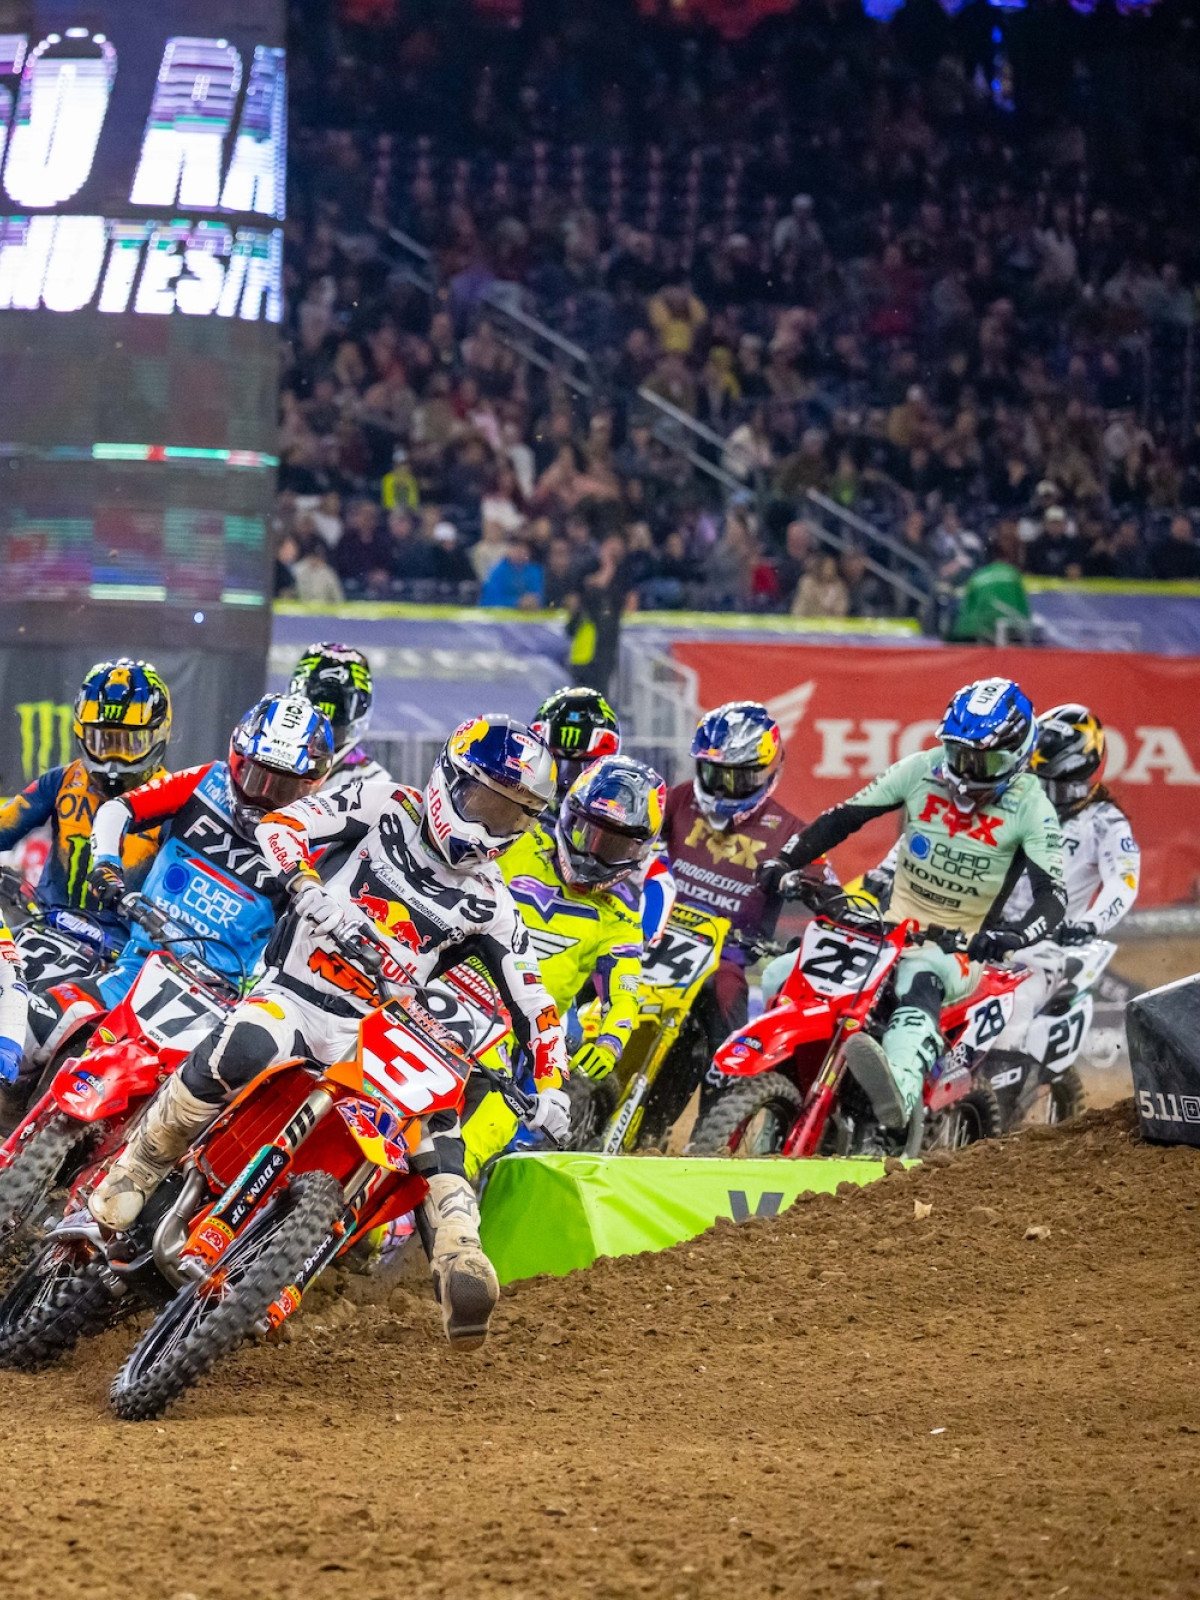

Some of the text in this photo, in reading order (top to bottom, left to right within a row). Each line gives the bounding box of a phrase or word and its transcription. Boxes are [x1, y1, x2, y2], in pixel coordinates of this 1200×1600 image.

[429, 798, 452, 842] Bull
[902, 856, 980, 897] HONDA
[930, 856, 985, 882] LOCK
[933, 842, 990, 870] QUAD
[190, 875, 242, 916] QUAD
[672, 858, 757, 897] PROGRESSIVE
[675, 878, 742, 912] SUZUKI
[155, 896, 221, 940] HONDA
[182, 888, 237, 929] LOCK
[1023, 915, 1049, 941] MTF
[802, 937, 878, 985] 28
[135, 977, 212, 1039] 17
[974, 998, 1006, 1047] 28
[1044, 1007, 1086, 1066] 27
[362, 1027, 458, 1113] 3
[1139, 1089, 1183, 1123] 5.11
